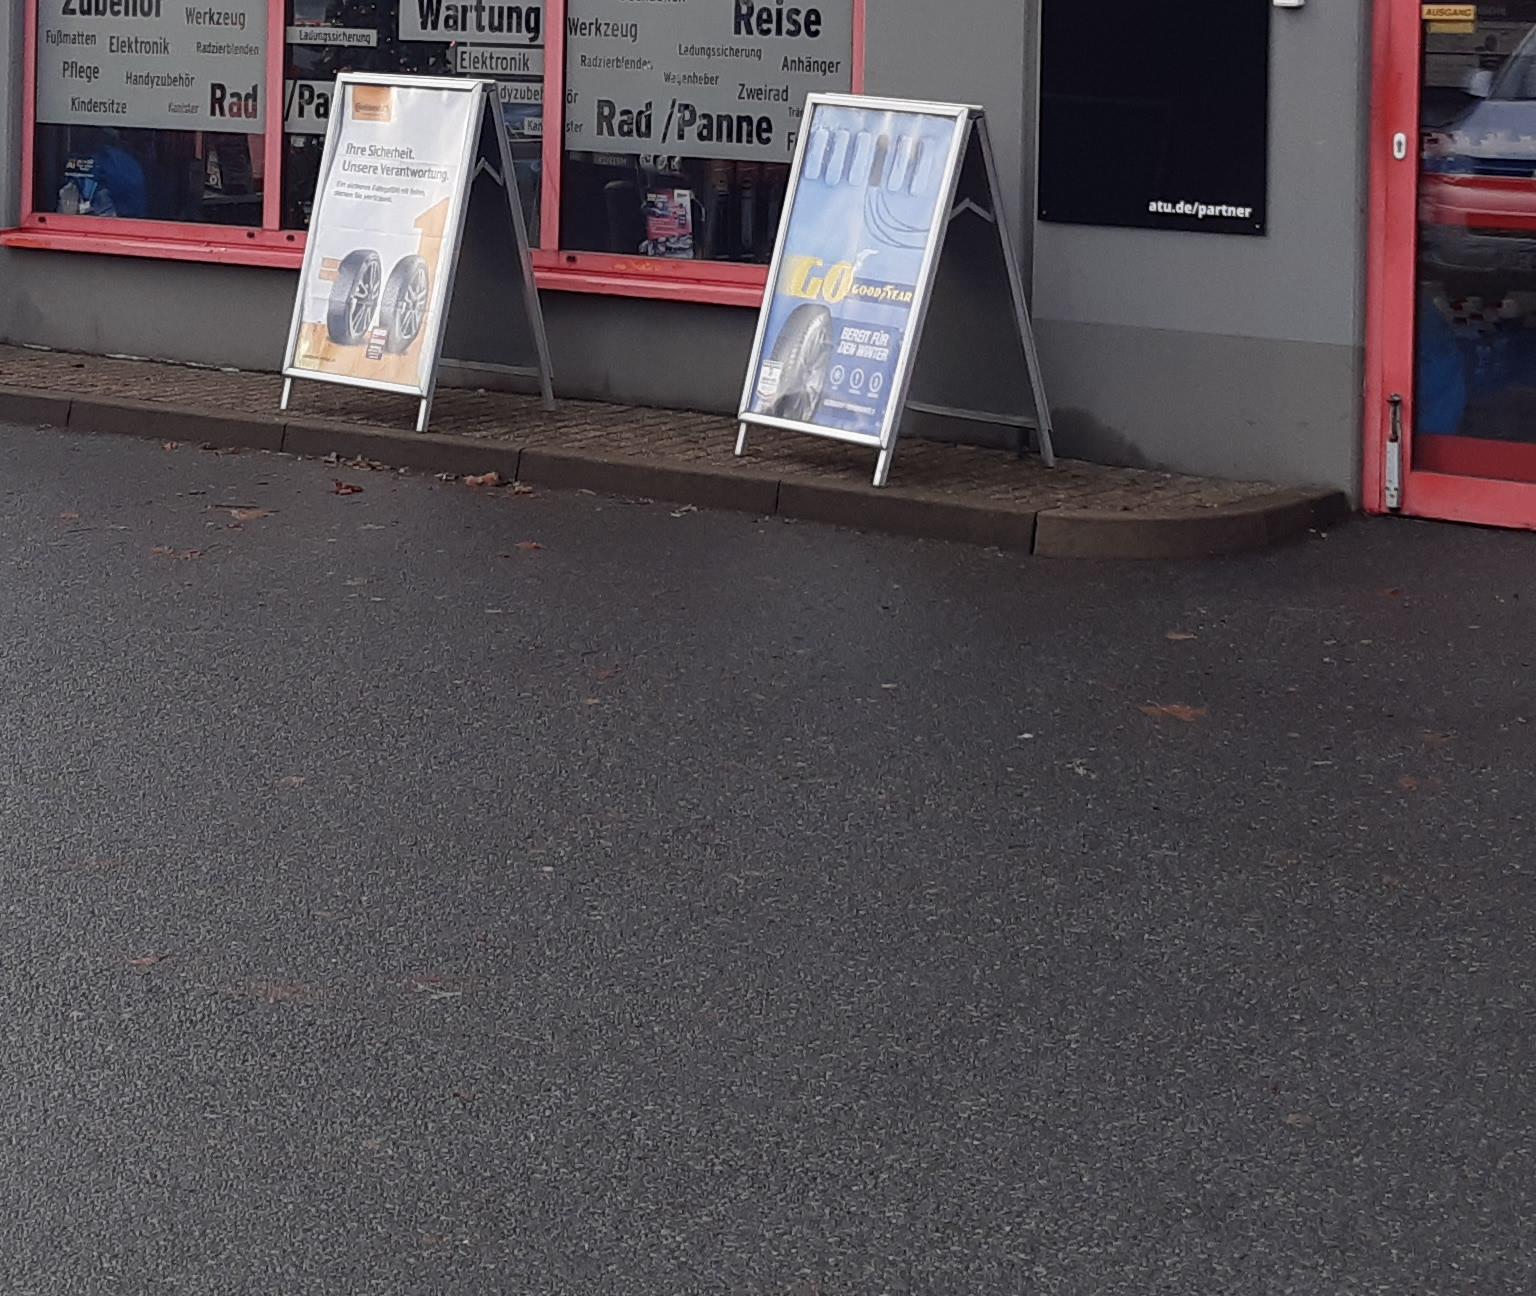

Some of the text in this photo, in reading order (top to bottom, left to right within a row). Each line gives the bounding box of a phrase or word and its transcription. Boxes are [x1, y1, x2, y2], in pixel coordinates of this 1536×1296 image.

[185, 7, 245, 30] Werkzeug
[45, 30, 96, 46] Fußmatten
[568, 17, 638, 42] Werkzeug
[109, 36, 170, 54] Elektronik
[679, 44, 762, 61] Ladungssicherung
[460, 51, 530, 73] Elektronik
[782, 56, 840, 76] Anhänger
[62, 61, 100, 83] Pflege
[125, 71, 195, 89] Handyzubehör
[738, 84, 789, 102] Zweirad
[71, 97, 127, 114] Kindersitze
[596, 99, 652, 139] Rad
[346, 142, 415, 160] Ihre Sicherheit.
[342, 160, 449, 182] Unsere Verantwortung.
[1149, 200, 1252, 218] atu.de/partner
[790, 256, 853, 304] GO
[852, 284, 912, 302] GOODYEAR
